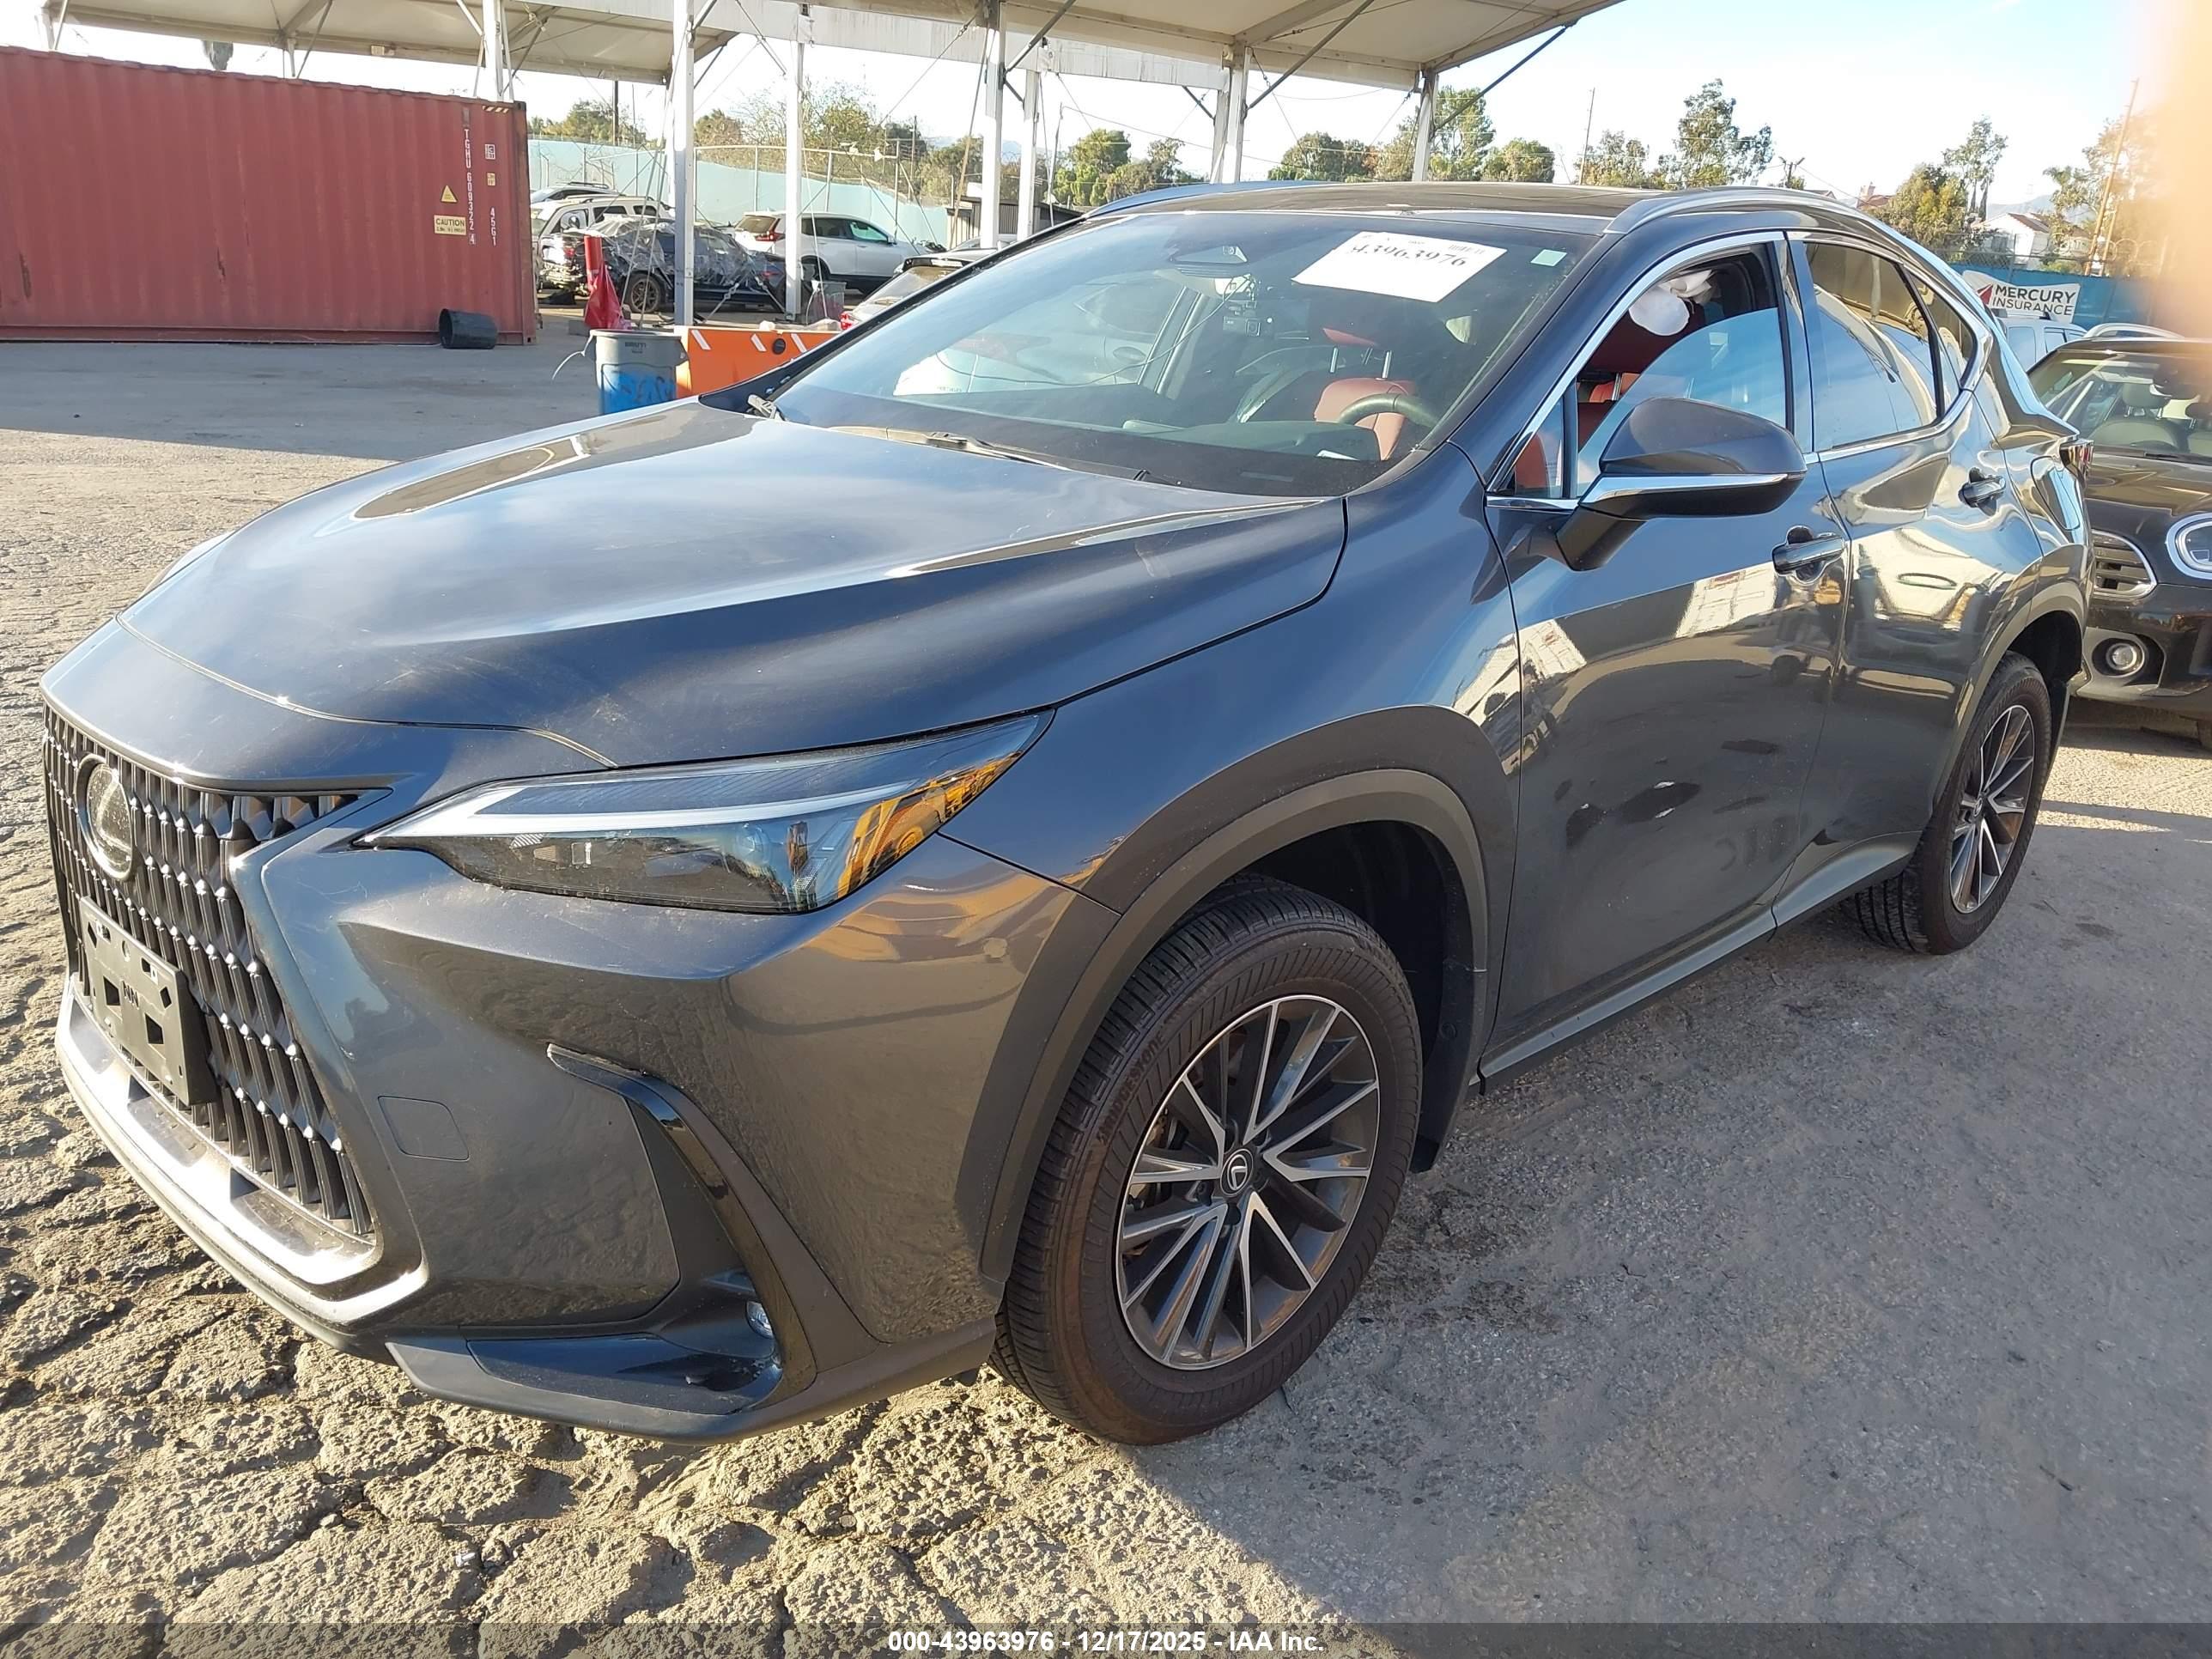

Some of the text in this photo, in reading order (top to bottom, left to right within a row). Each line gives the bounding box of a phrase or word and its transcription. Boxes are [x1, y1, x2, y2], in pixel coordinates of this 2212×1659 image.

[435, 218, 465, 227] CAUTION
[1995, 284, 2076, 304] MERCURY
[1992, 296, 2074, 316] INSURANCE
[1096, 1030, 1165, 1146] BRIDGESTONE
